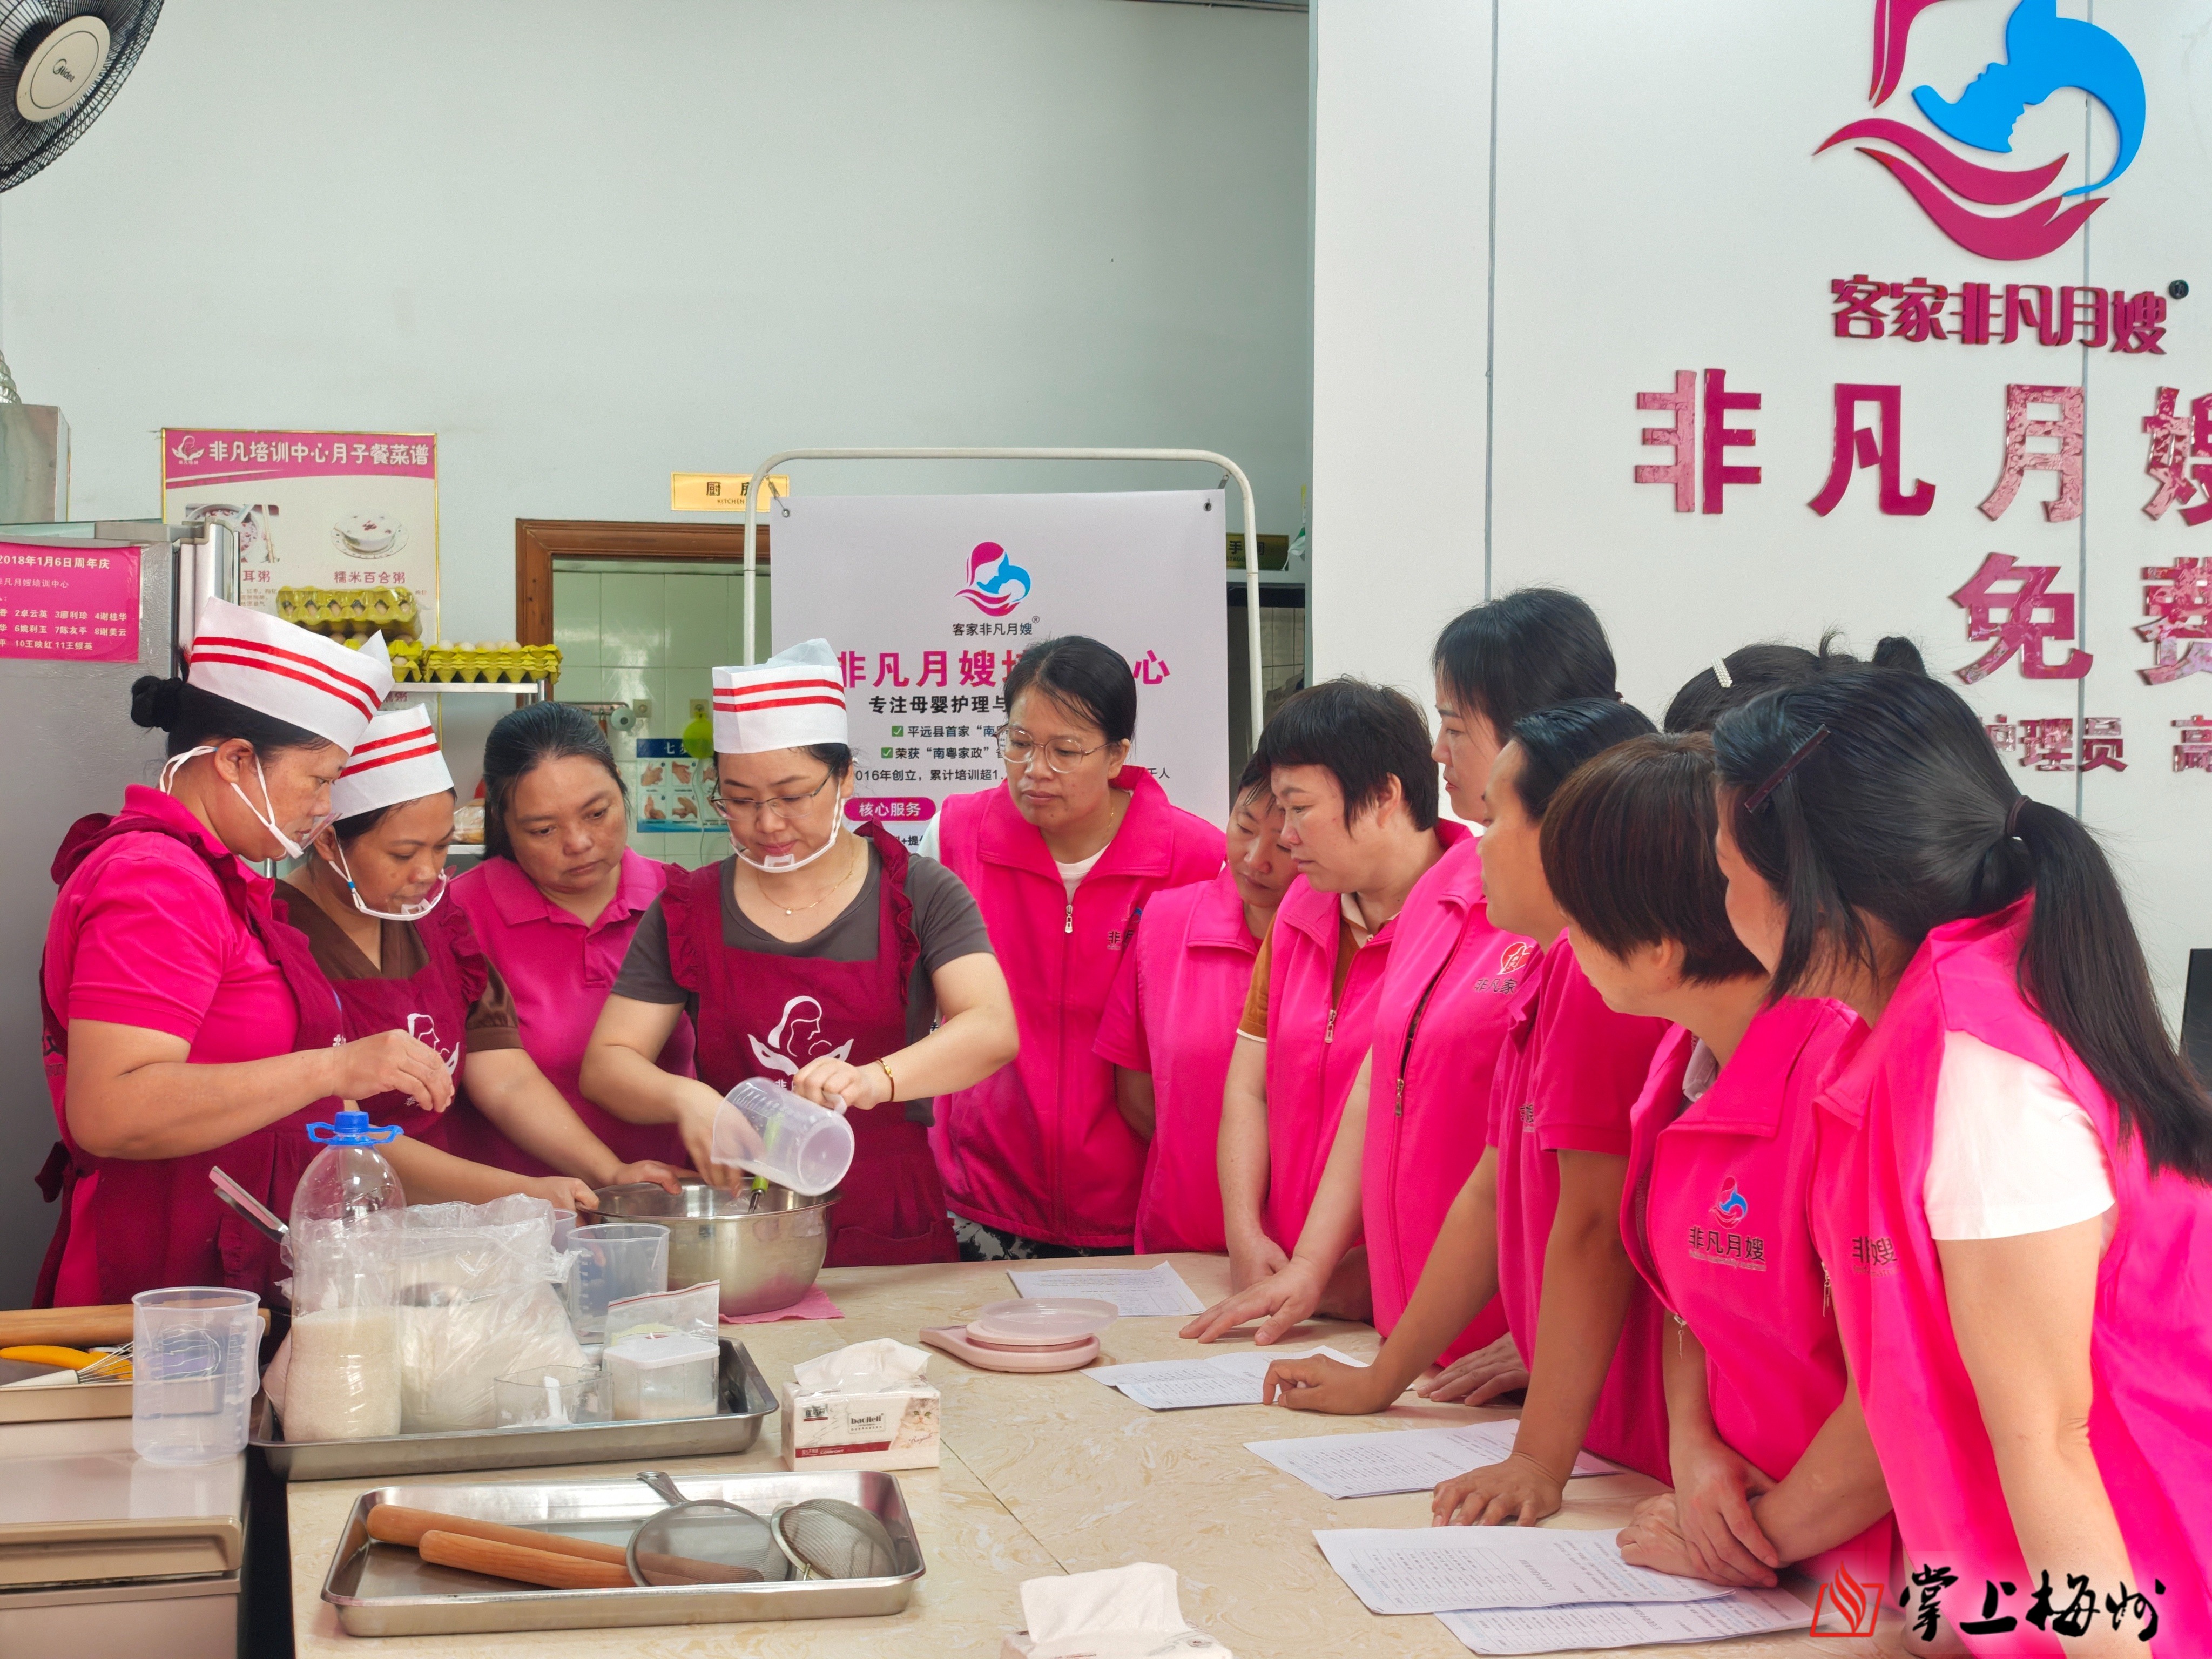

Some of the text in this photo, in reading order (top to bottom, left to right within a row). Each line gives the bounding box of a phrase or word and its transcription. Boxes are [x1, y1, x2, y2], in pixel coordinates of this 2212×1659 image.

[53, 58, 75, 82] Midea
[1831, 274, 2167, 354] 客家非凡月嫂
[209, 440, 429, 466] 非凡培训中心月子餐菜谱
[334, 571, 406, 584] 糯米百合粥
[952, 622, 1033, 636] 客家非凡月嫂
[859, 802, 921, 817] 核心服务
[1688, 1226, 1765, 1262] 非凡月嫂
